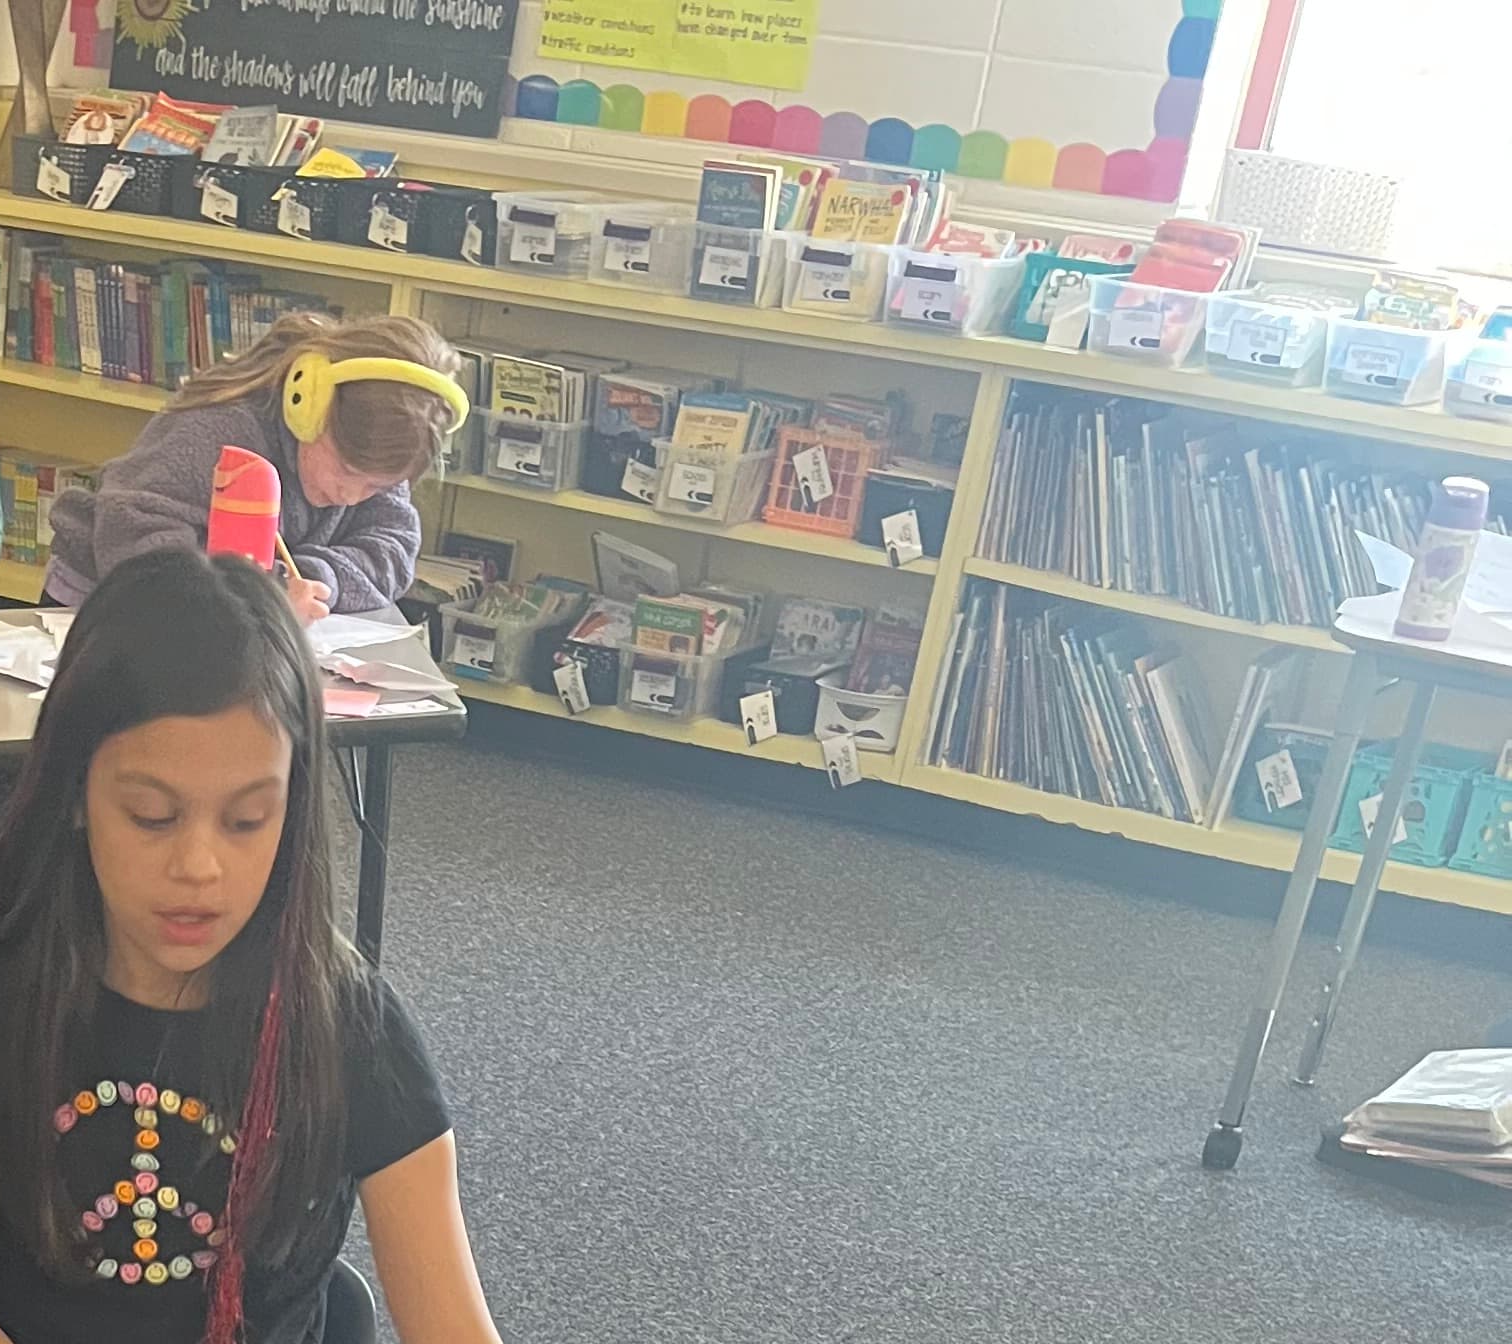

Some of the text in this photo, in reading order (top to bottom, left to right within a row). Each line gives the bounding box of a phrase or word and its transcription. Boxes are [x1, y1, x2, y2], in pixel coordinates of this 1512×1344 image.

[156, 46, 484, 119] and the shadows will fall behind you
